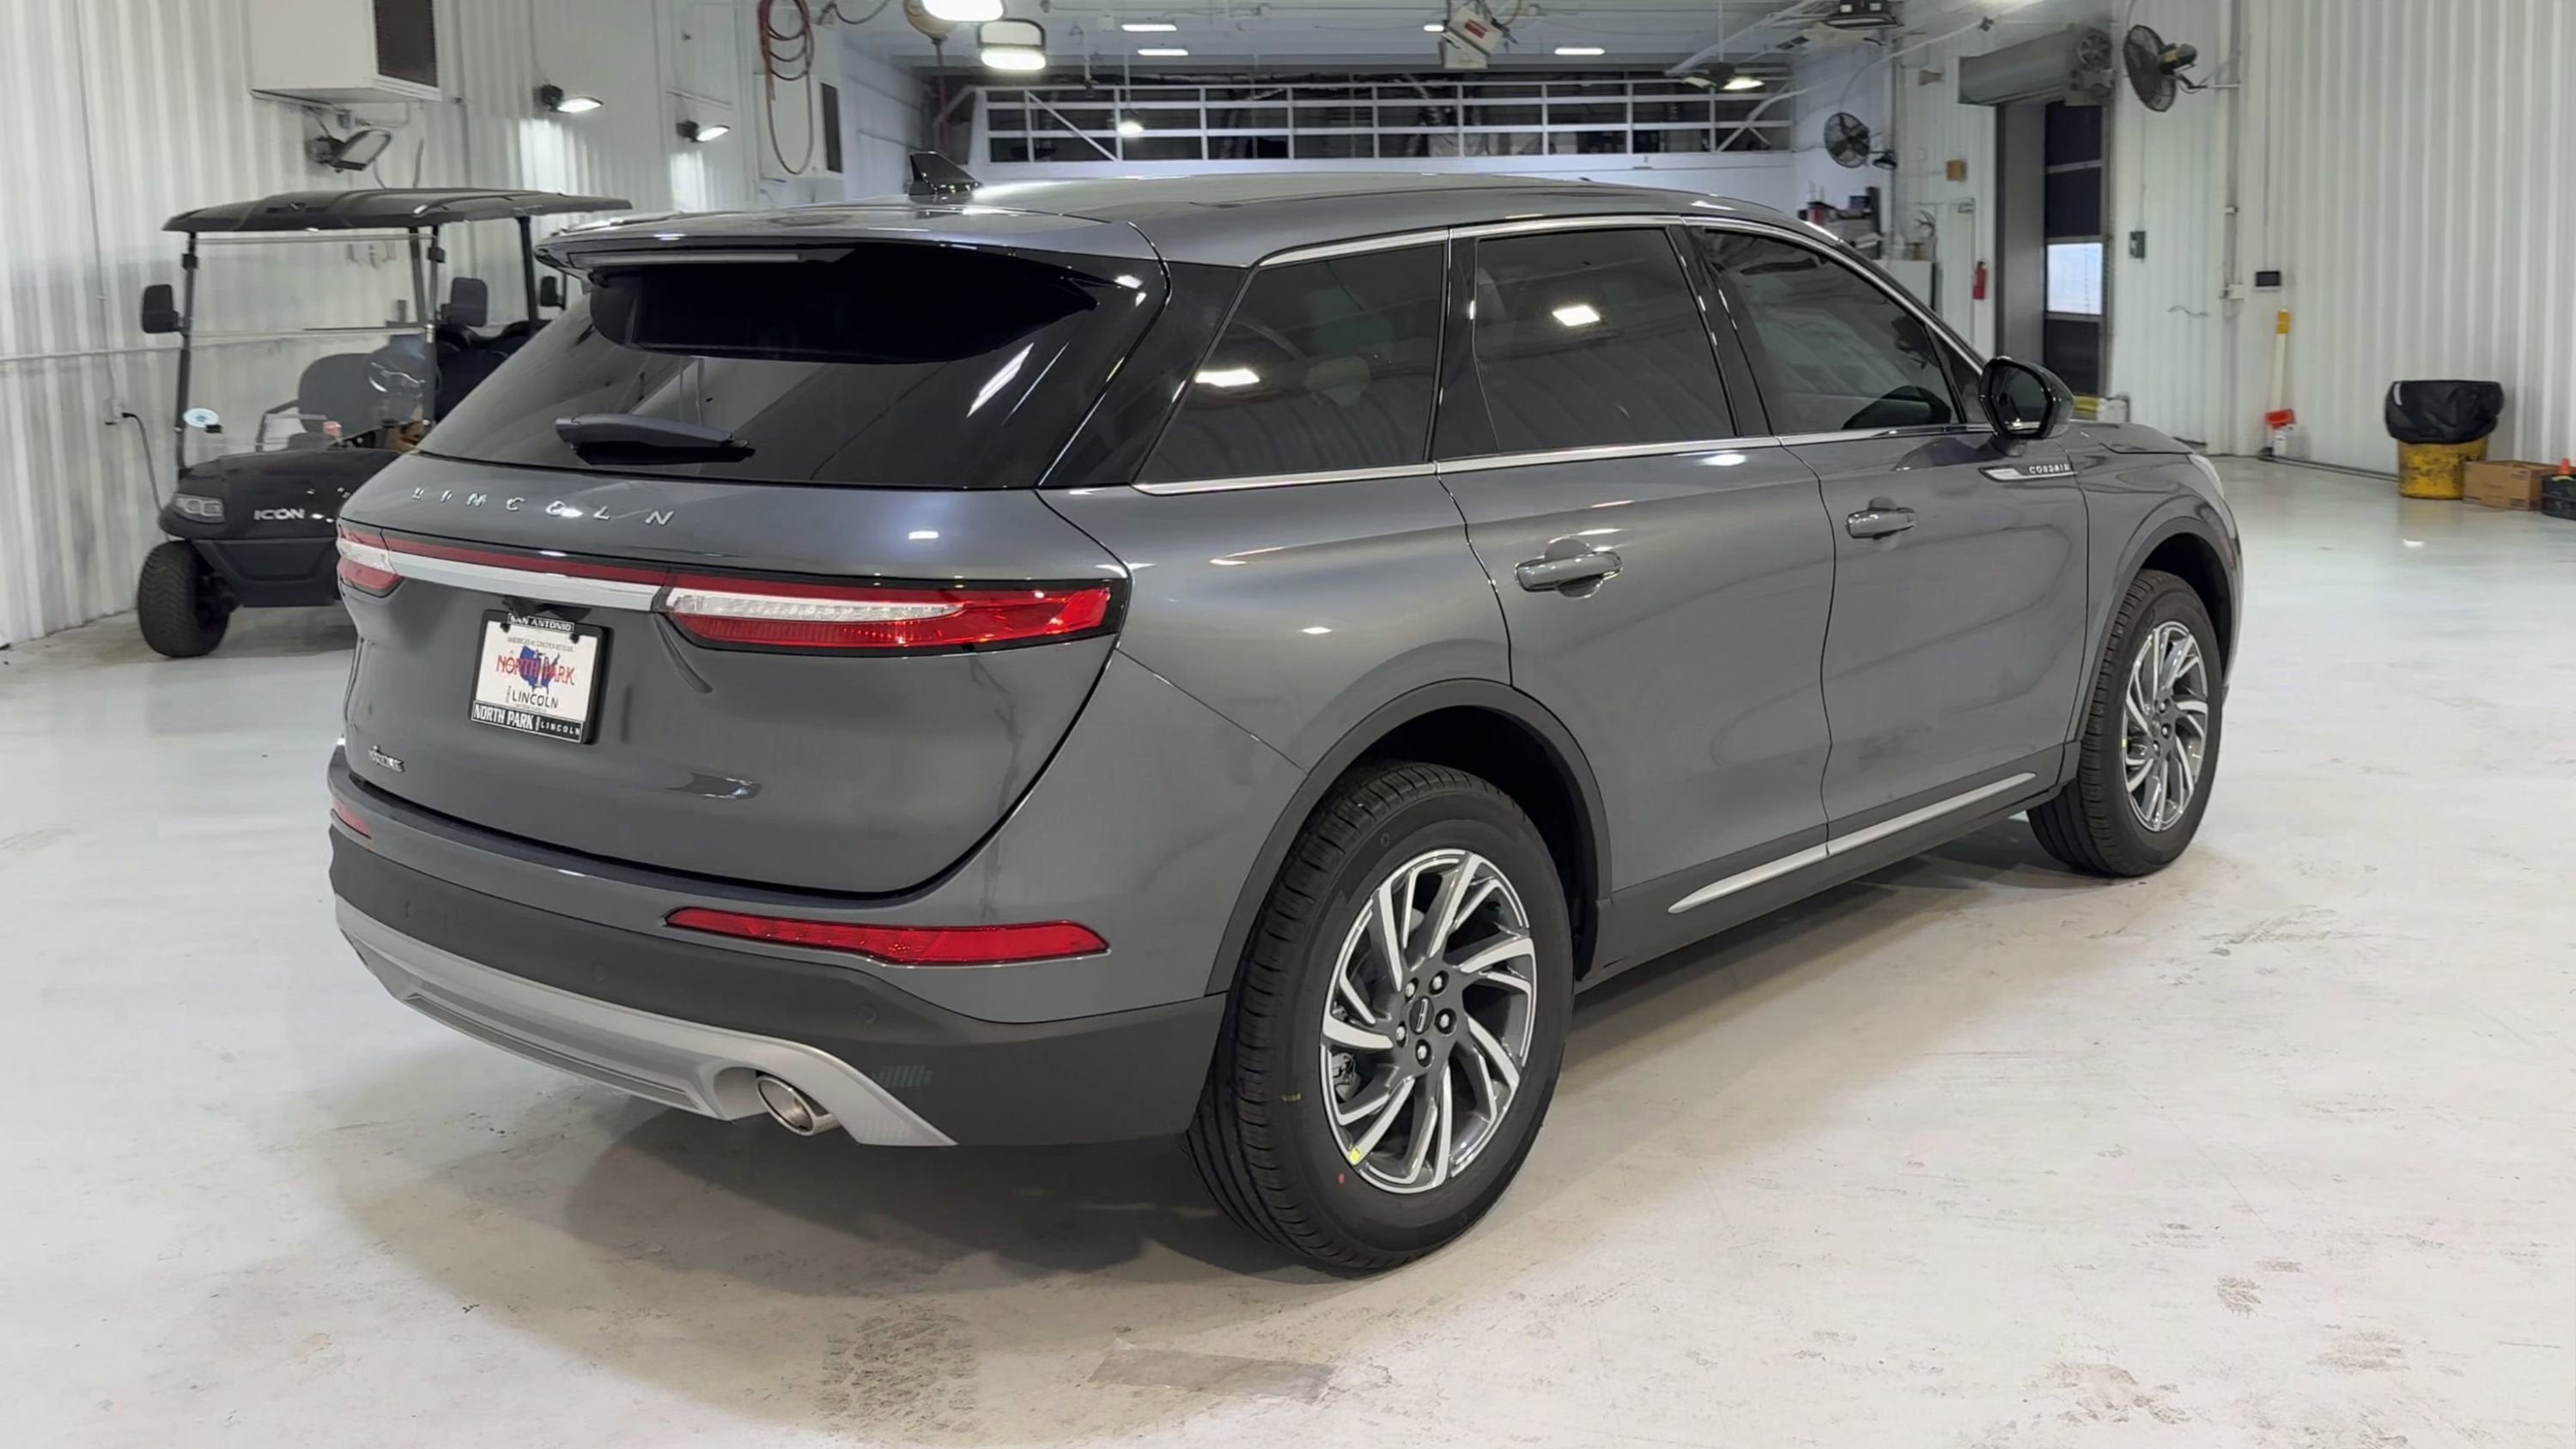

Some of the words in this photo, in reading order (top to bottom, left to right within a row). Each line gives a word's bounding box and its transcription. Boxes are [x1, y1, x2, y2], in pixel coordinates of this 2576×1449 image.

[2028, 464, 2070, 474] CORSAIR
[253, 507, 305, 521] ICON
[411, 487, 674, 525] LINCOLN
[510, 615, 529, 625] SAN
[531, 619, 572, 631] ANTONIO
[495, 655, 540, 676] NORTH
[544, 662, 575, 686] PARK
[512, 689, 559, 709] LINCOLN
[473, 704, 506, 724] NORTH
[506, 709, 534, 731] PARK
[540, 722, 580, 736] LINCOLN
